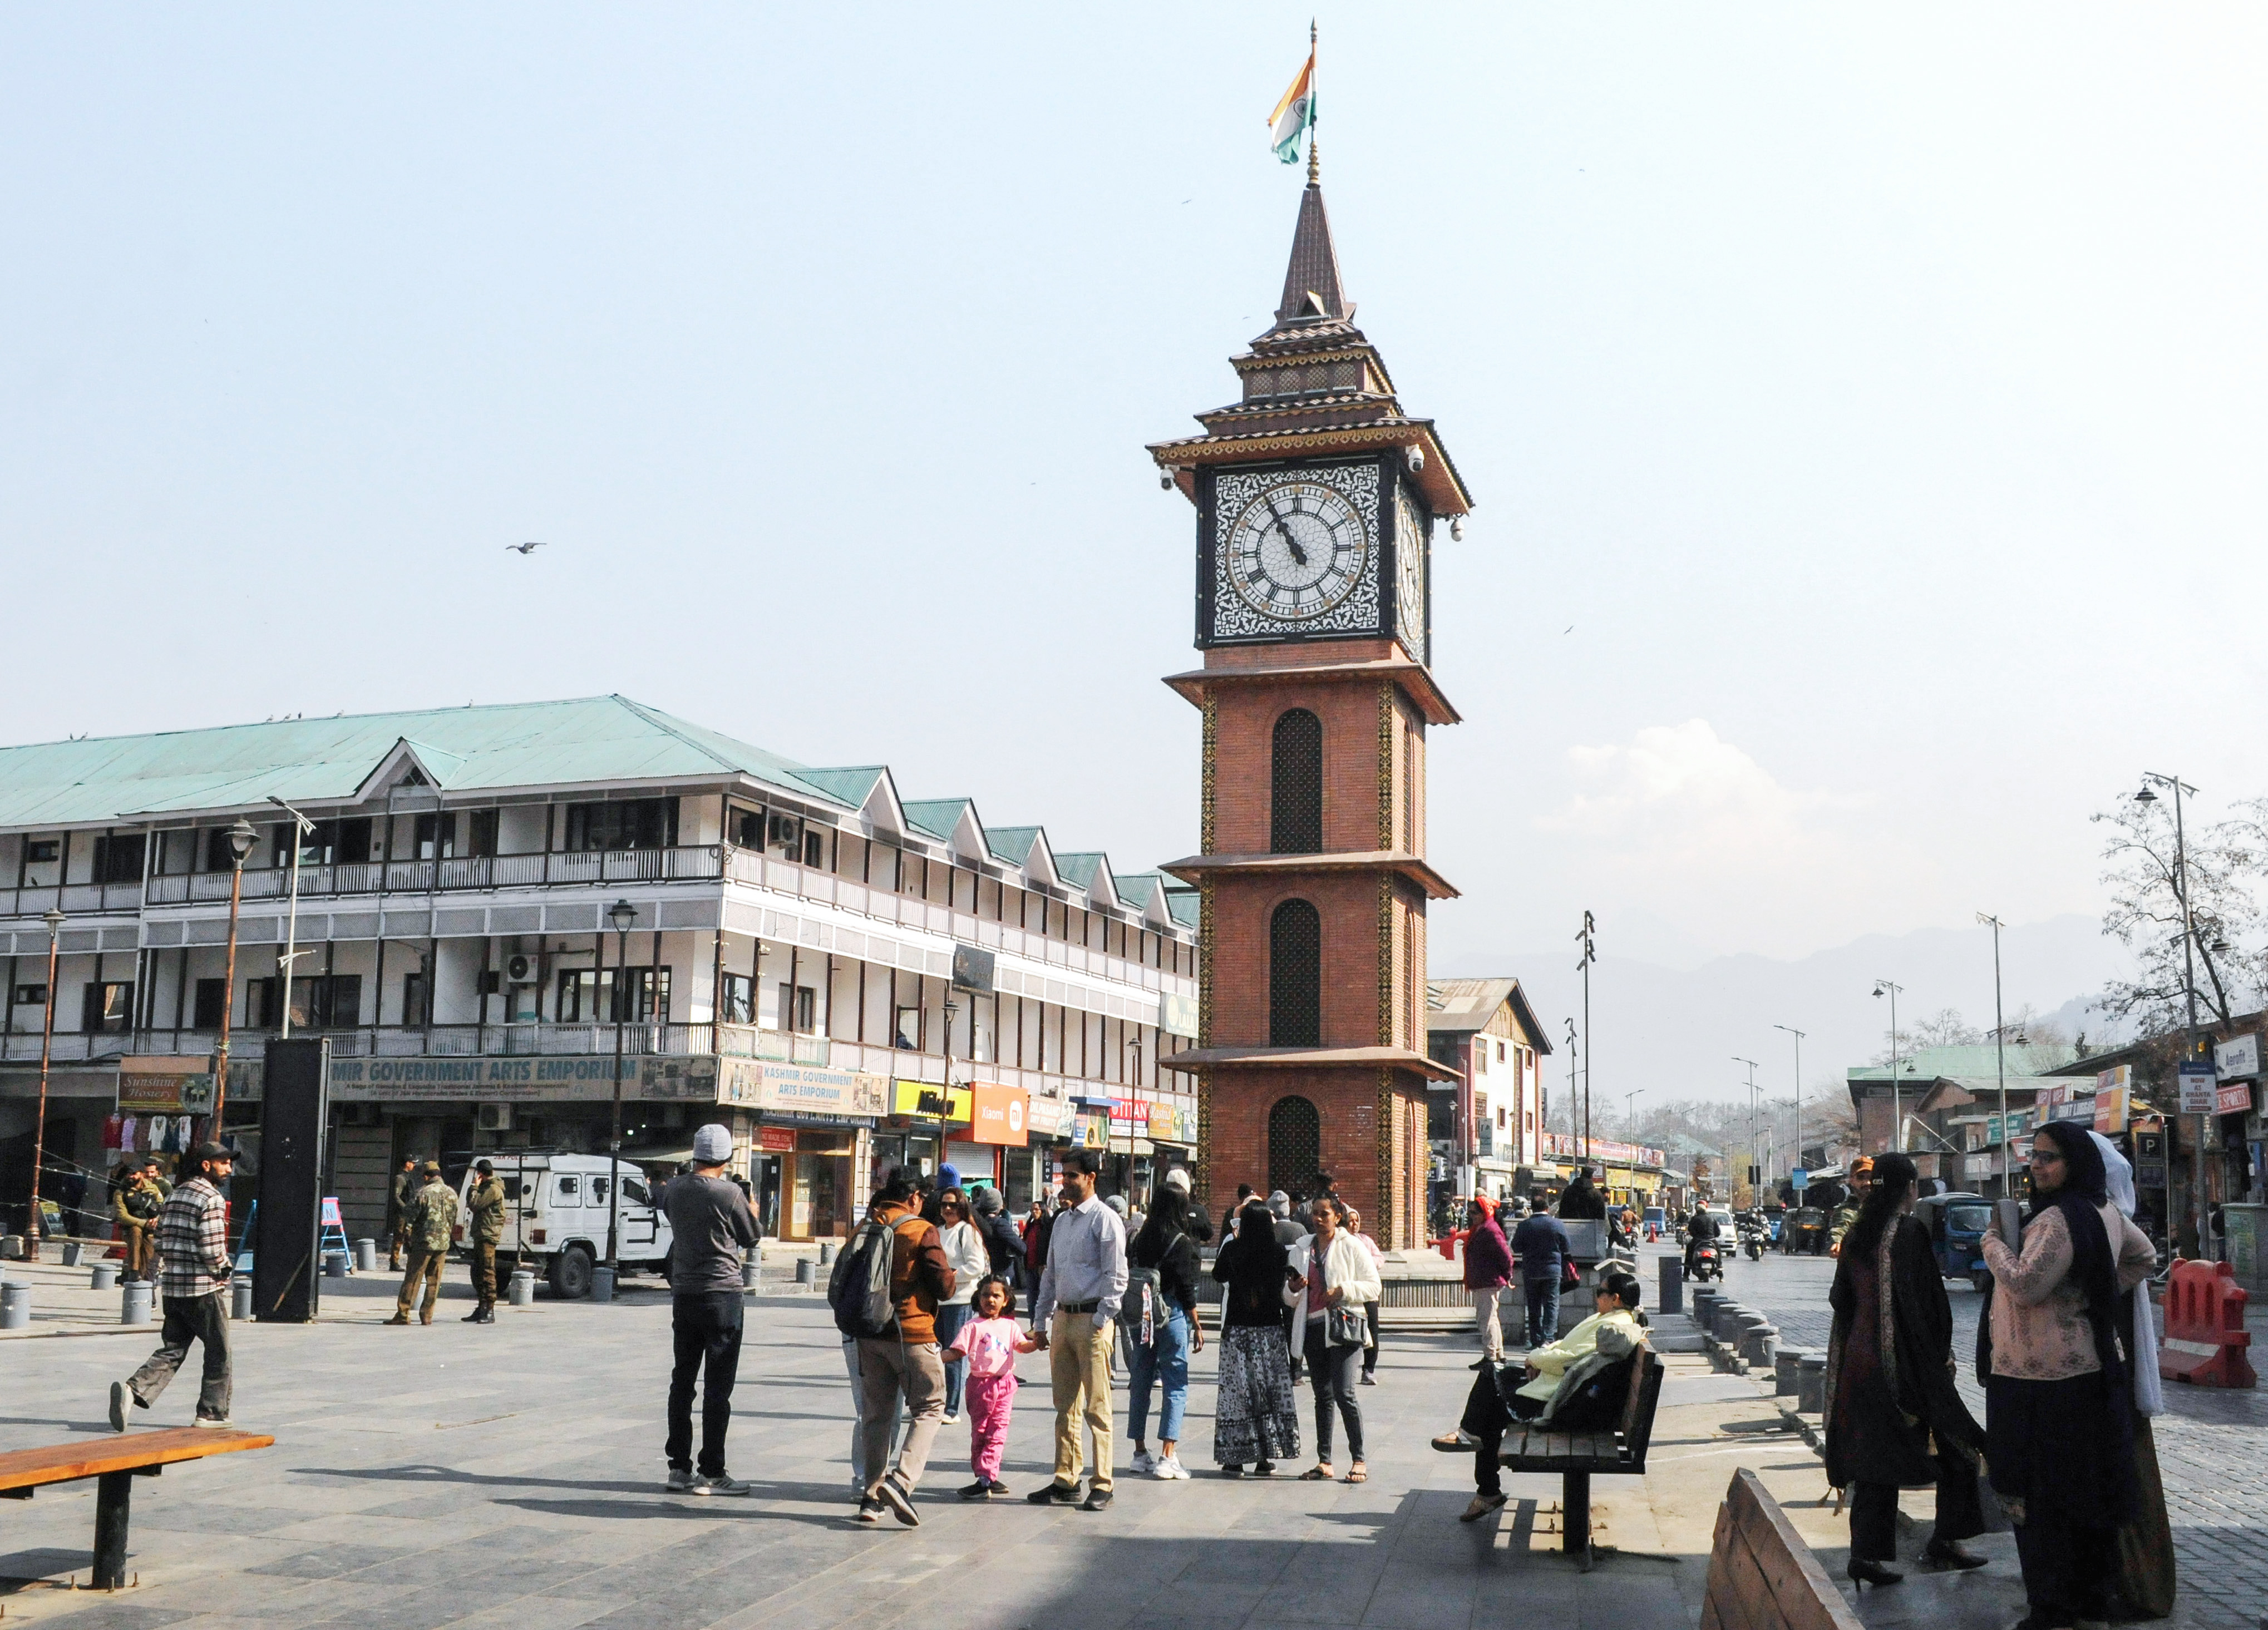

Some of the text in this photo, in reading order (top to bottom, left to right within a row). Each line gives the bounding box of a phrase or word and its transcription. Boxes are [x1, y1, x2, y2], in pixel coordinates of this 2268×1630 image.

[1187, 1000, 1199, 1014] HO
[1179, 1012, 1195, 1030] LALA
[369, 1061, 484, 1081] GOVERNMENT
[489, 1061, 531, 1080] ARTS
[537, 1060, 637, 1080] EMPORIUM
[764, 1066, 853, 1086] KASHMIR GOVERNMENT
[125, 1075, 177, 1087] Sunshine
[778, 1084, 840, 1100] ARTS EMPORIUM
[981, 1106, 1004, 1121] Xiaomi
[1029, 1100, 1061, 1117] DILPASAND
[1120, 1101, 1147, 1119] TITAN
[1149, 1105, 1173, 1122] Rashid
[1040, 1116, 1057, 1128] FRUITS
[2146, 1139, 2155, 1152] P
